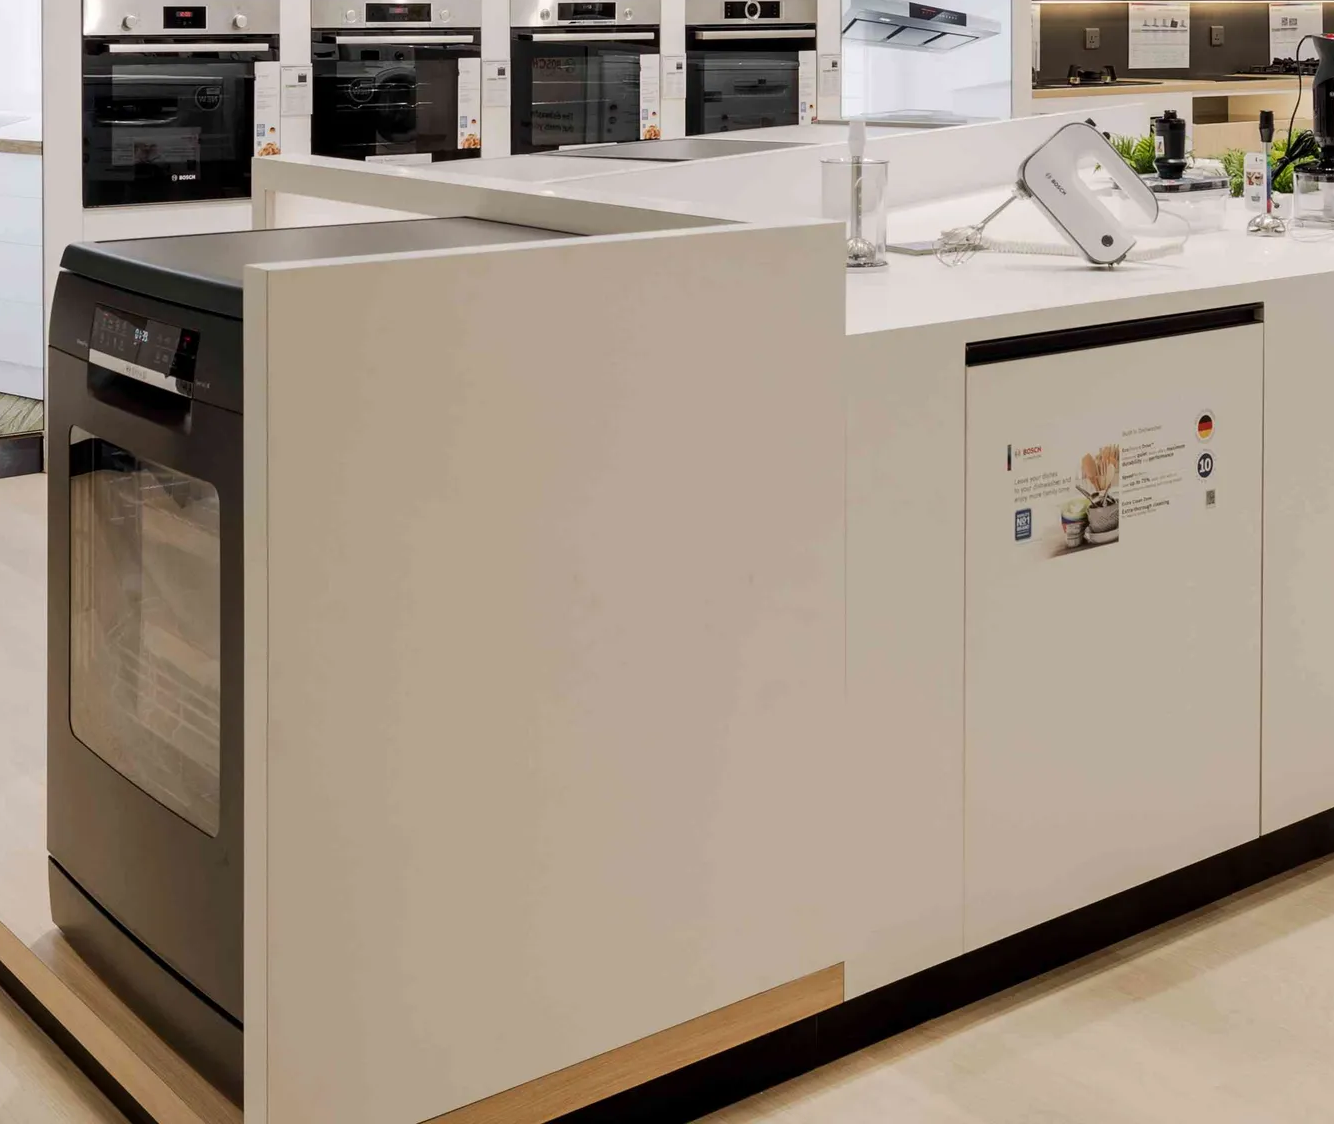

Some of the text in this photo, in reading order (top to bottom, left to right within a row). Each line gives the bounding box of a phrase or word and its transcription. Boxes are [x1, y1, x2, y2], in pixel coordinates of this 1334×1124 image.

[1050, 178, 1067, 196] BOSCH
[1022, 446, 1042, 456] BOSCH
[1198, 457, 1212, 474] 10
